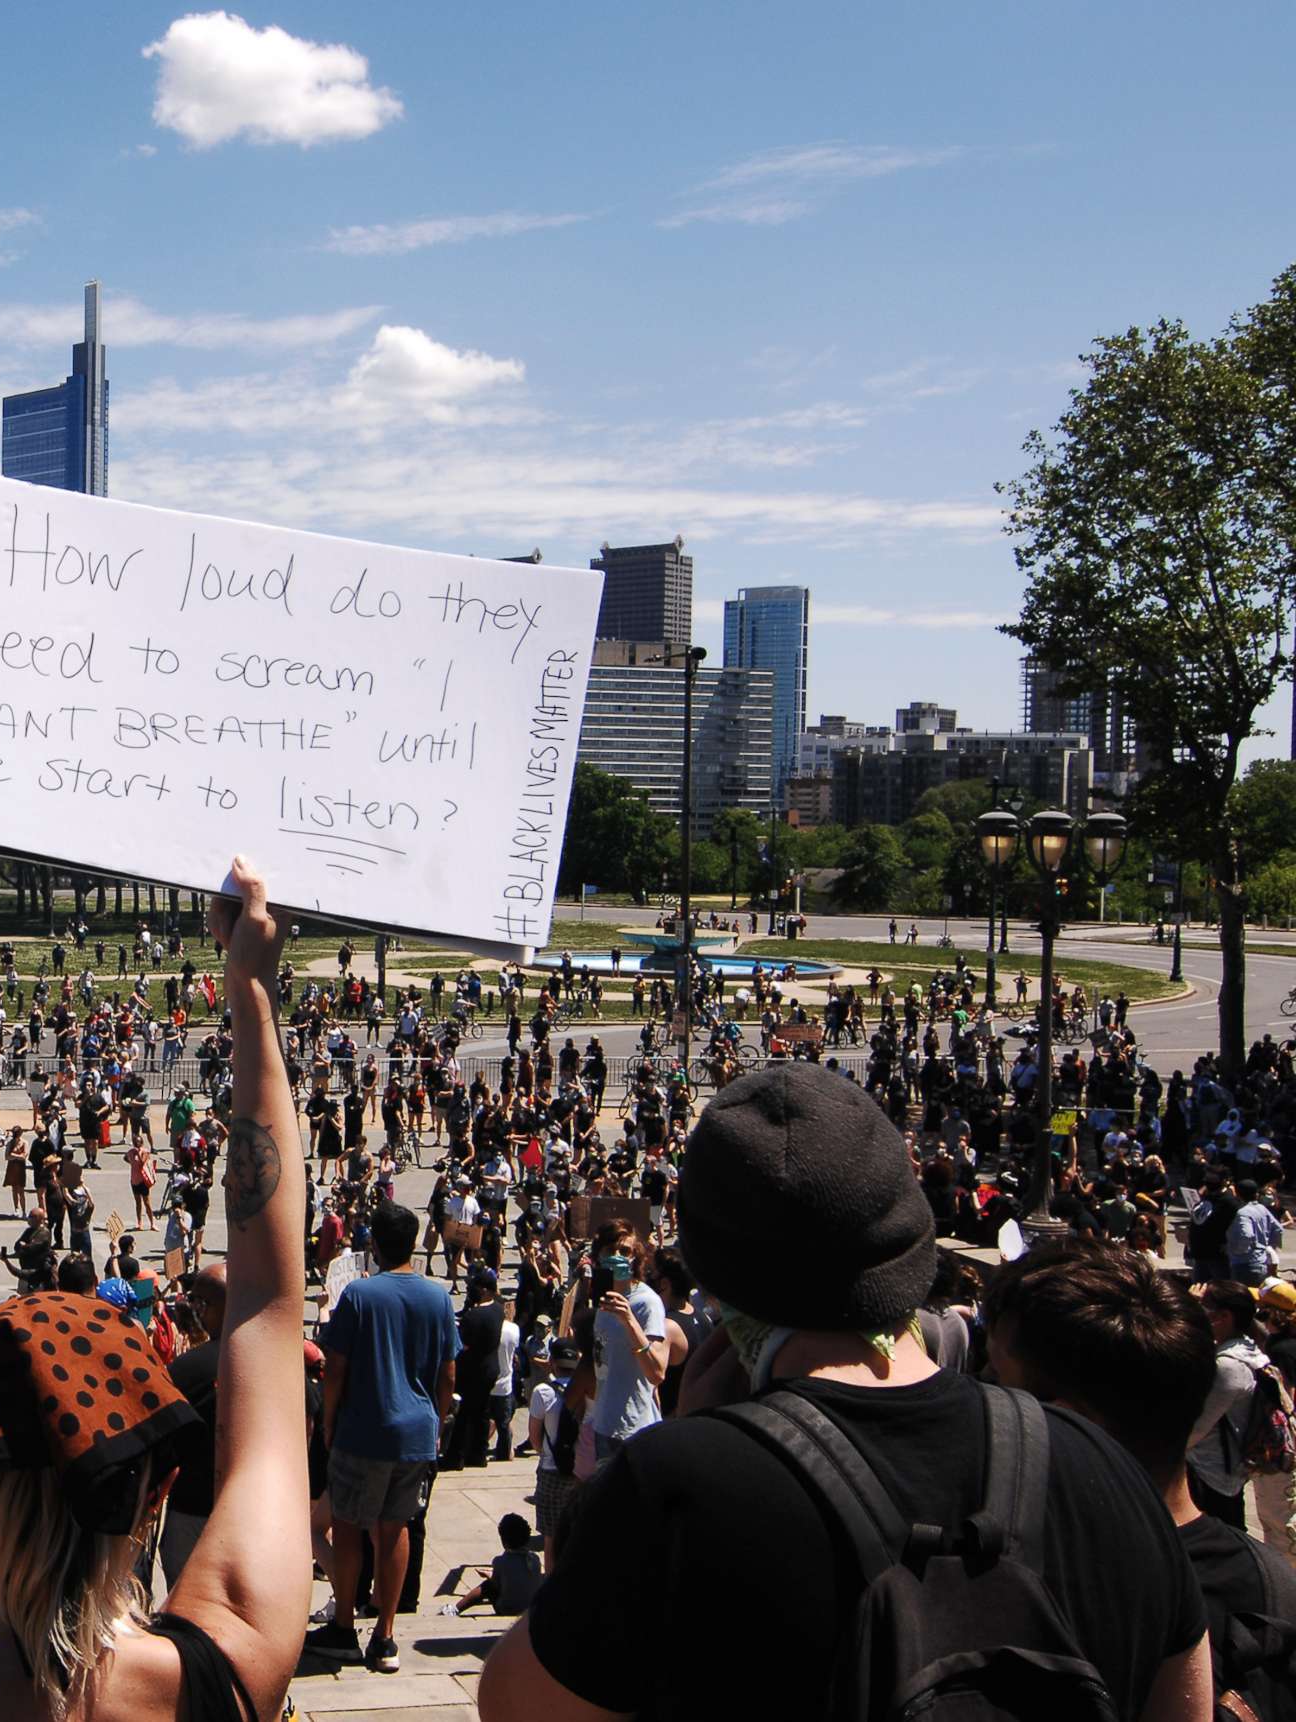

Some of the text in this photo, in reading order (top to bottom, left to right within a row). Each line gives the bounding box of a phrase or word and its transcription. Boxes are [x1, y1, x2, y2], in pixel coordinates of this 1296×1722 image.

[4, 503, 542, 664] How loud do they
[129, 637, 180, 675] to
[216, 653, 374, 696] scream
[379, 722, 477, 770] until
[37, 758, 172, 801] start
[198, 776, 239, 810] to
[493, 650, 579, 940] #BLACKLIVESMATTER
